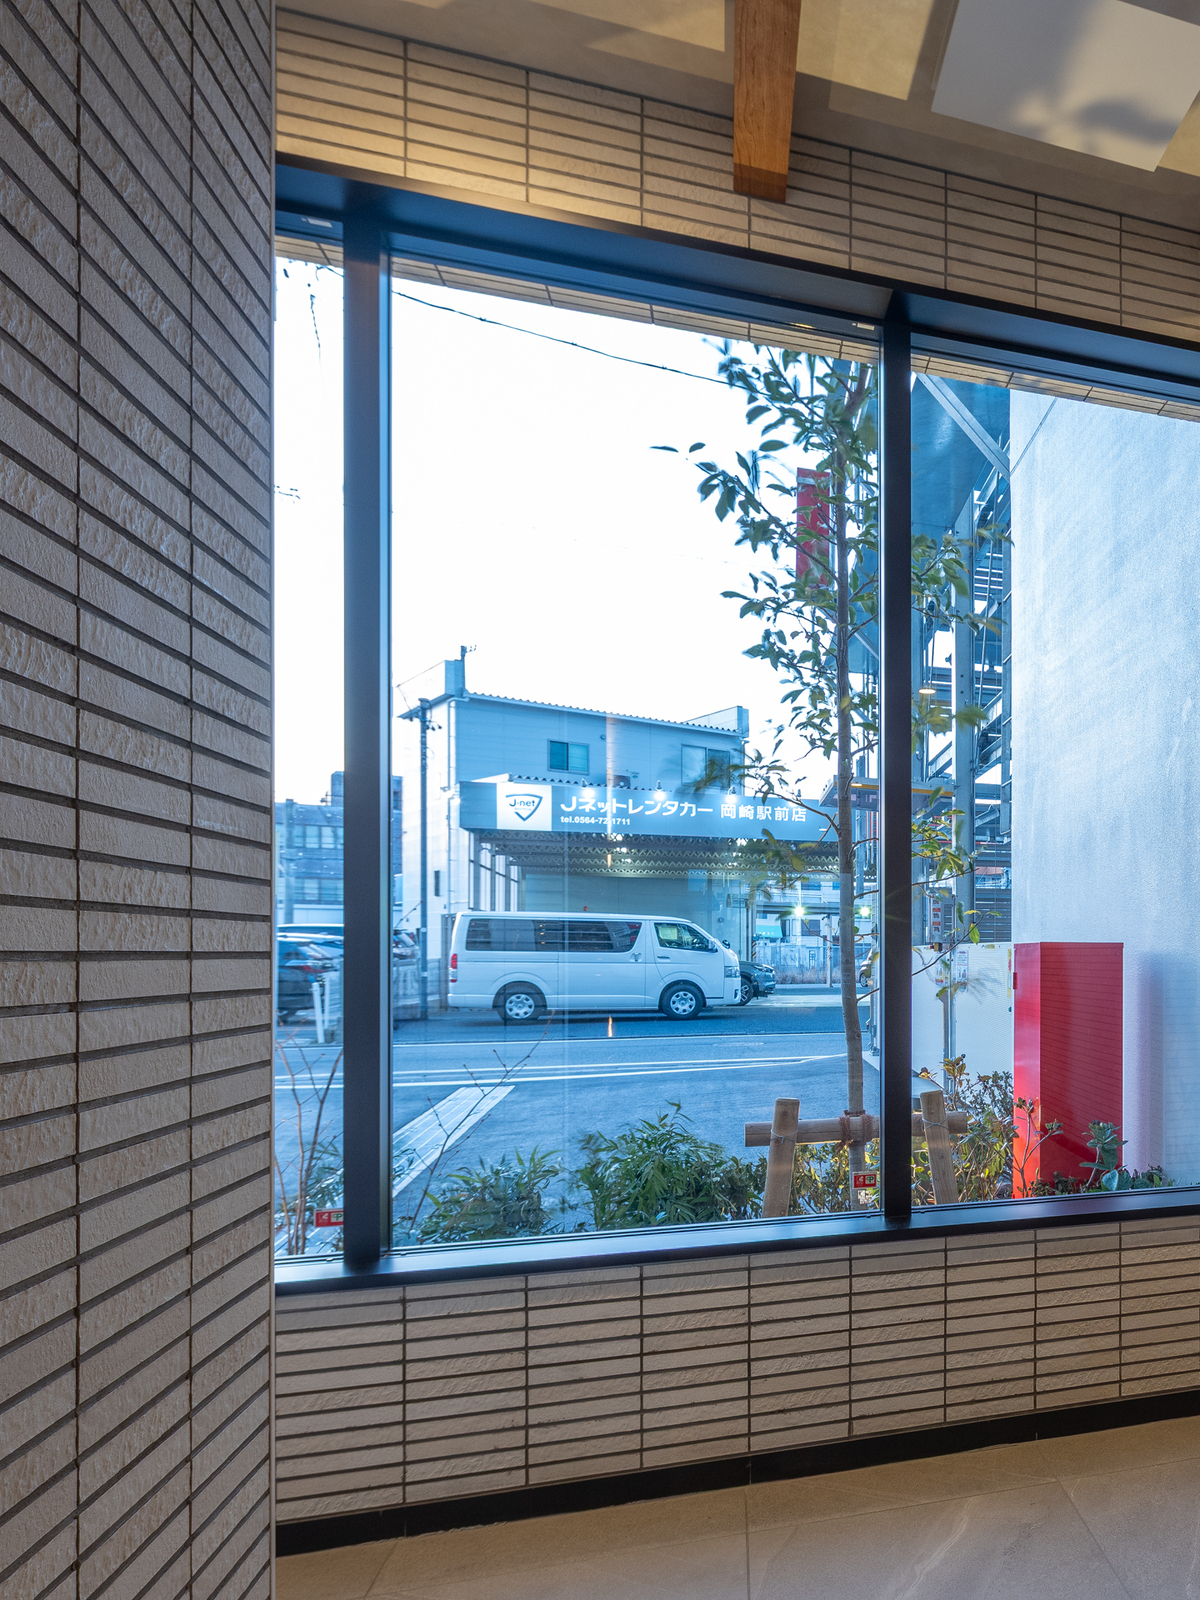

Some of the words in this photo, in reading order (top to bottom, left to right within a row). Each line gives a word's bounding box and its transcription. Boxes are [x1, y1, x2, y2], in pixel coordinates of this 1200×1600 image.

[509, 798, 536, 807] J-net
[560, 796, 714, 817] Jネットレンタカー
[720, 803, 807, 822] 岡崎駅前店
